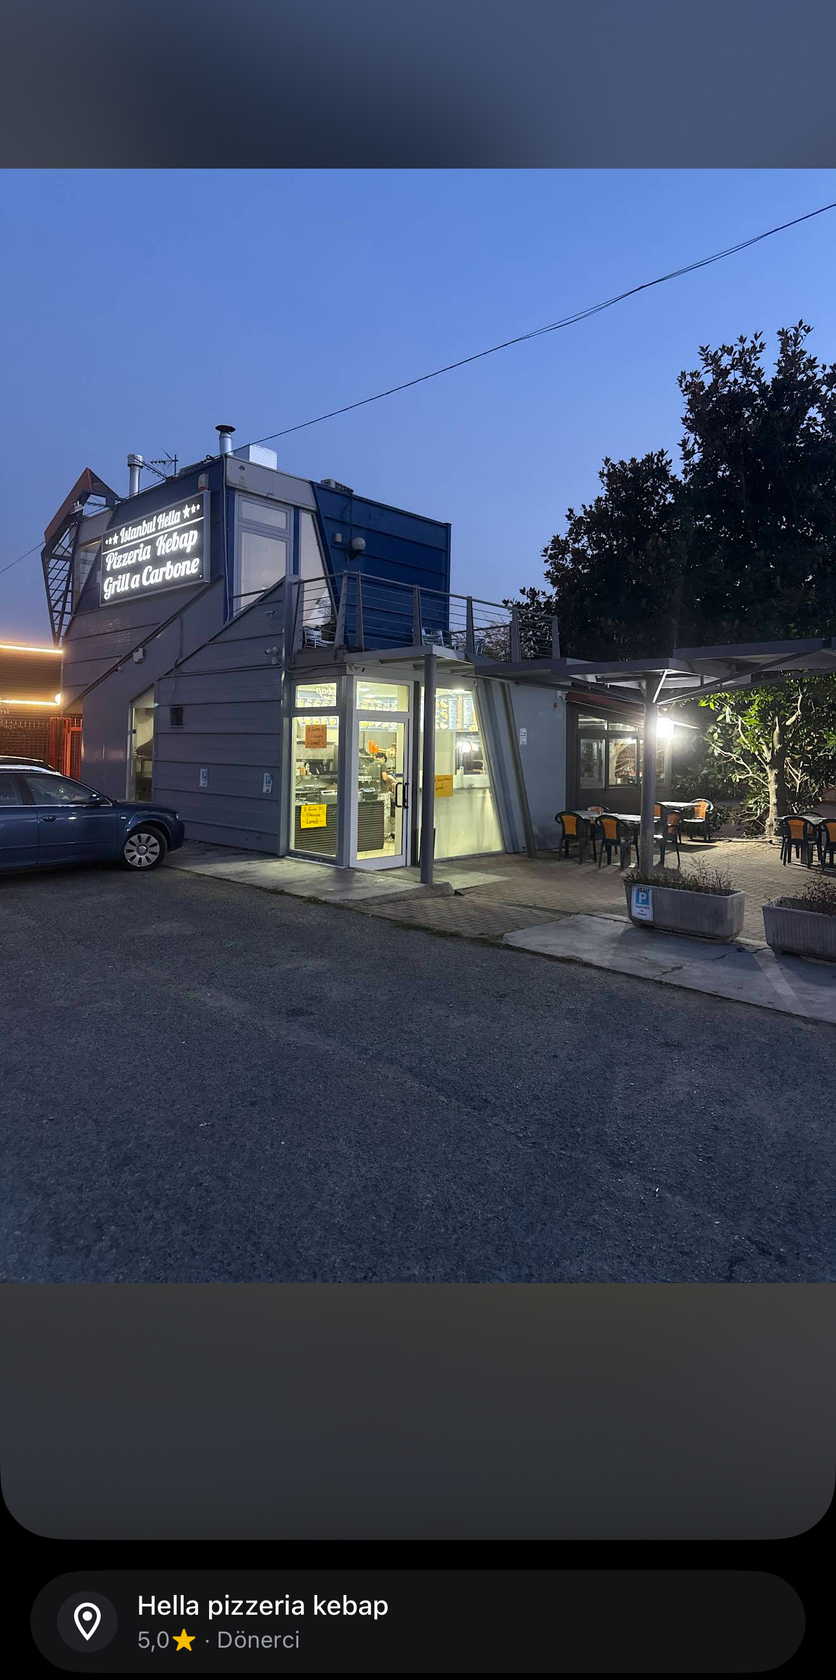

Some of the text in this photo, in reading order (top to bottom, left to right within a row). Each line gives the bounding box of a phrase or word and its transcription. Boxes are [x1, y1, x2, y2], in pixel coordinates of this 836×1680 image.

[120, 509, 180, 544] Istanbul Hella
[105, 530, 198, 571] Pizzeria Kebap
[103, 557, 200, 601] Grill a Carbone
[638, 892, 647, 903] P
